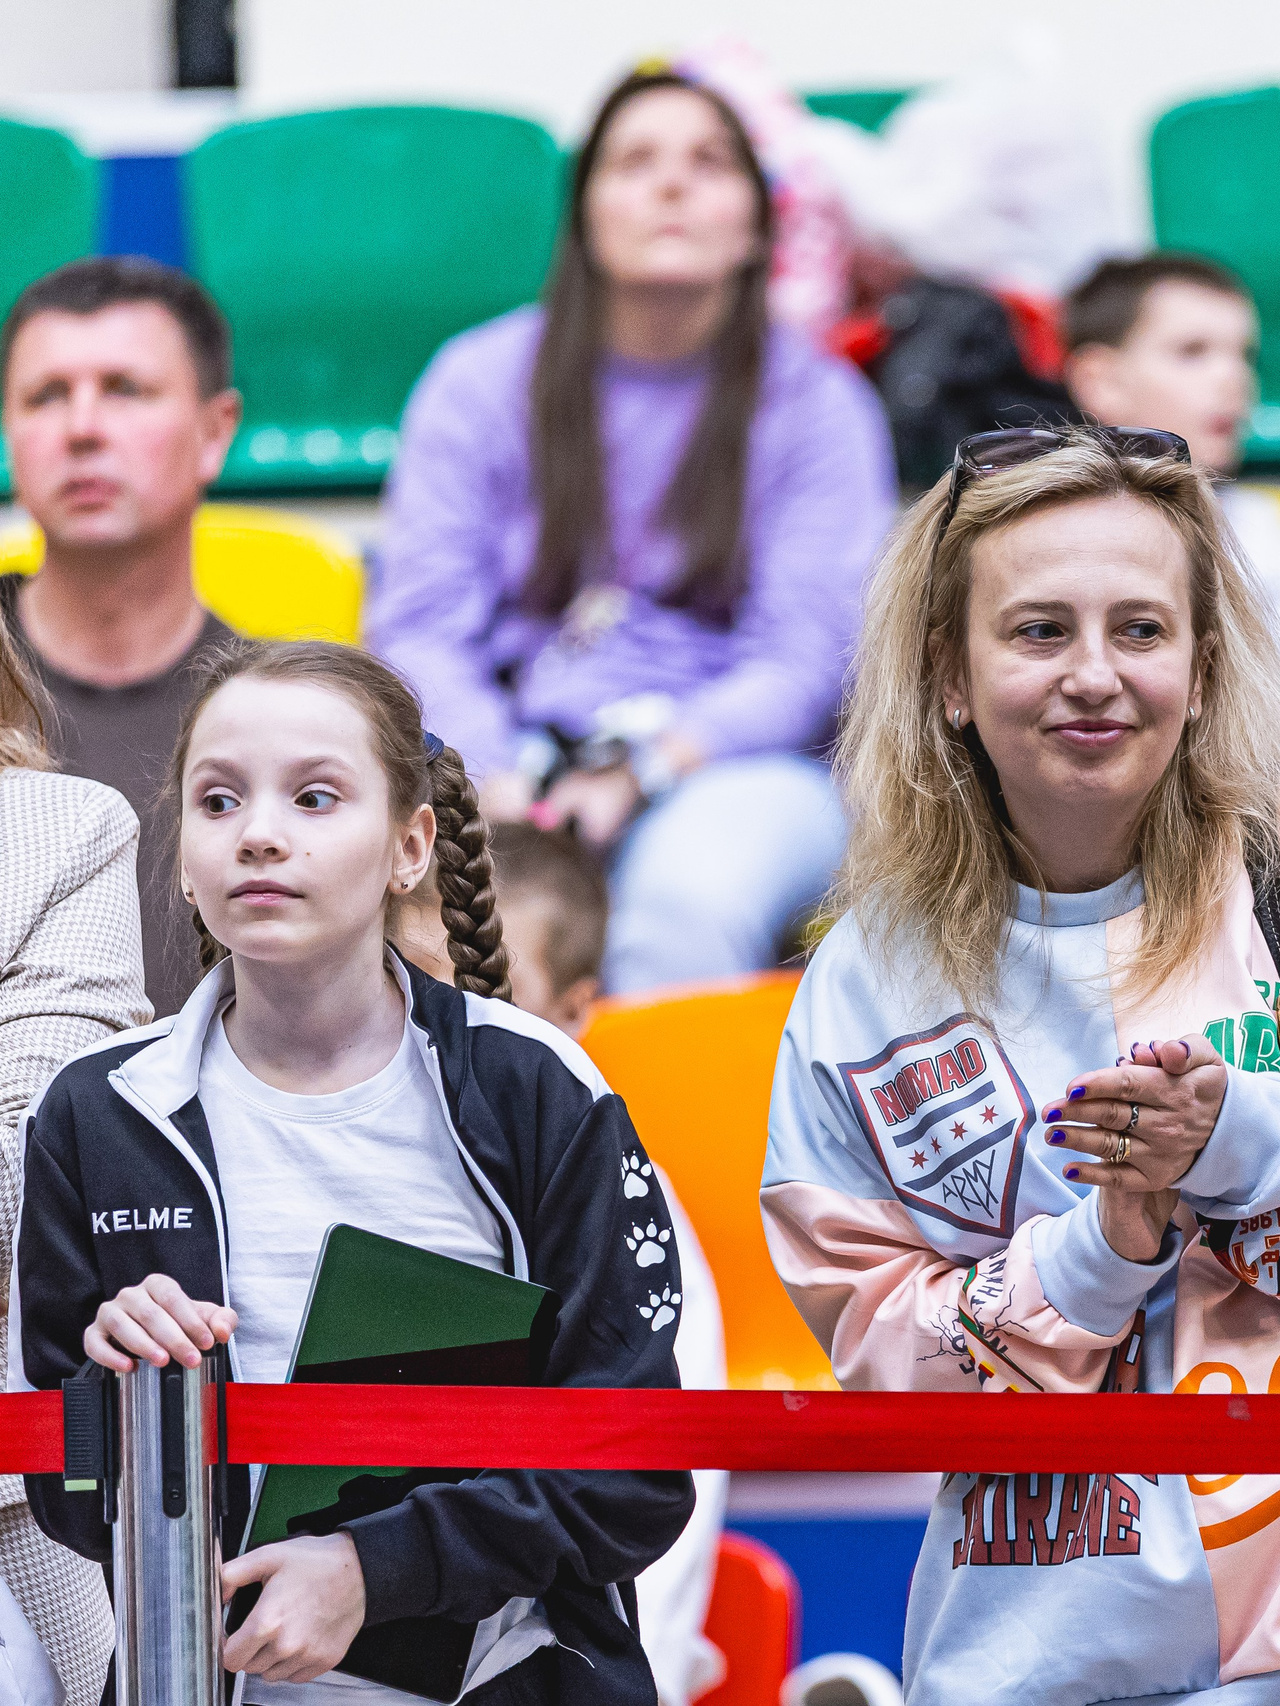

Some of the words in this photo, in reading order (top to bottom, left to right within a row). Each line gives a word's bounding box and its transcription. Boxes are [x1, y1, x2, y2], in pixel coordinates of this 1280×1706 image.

[870, 1037, 986, 1126] NOMAD
[942, 1149, 999, 1219] ARMY
[91, 1207, 193, 1234] KELME
